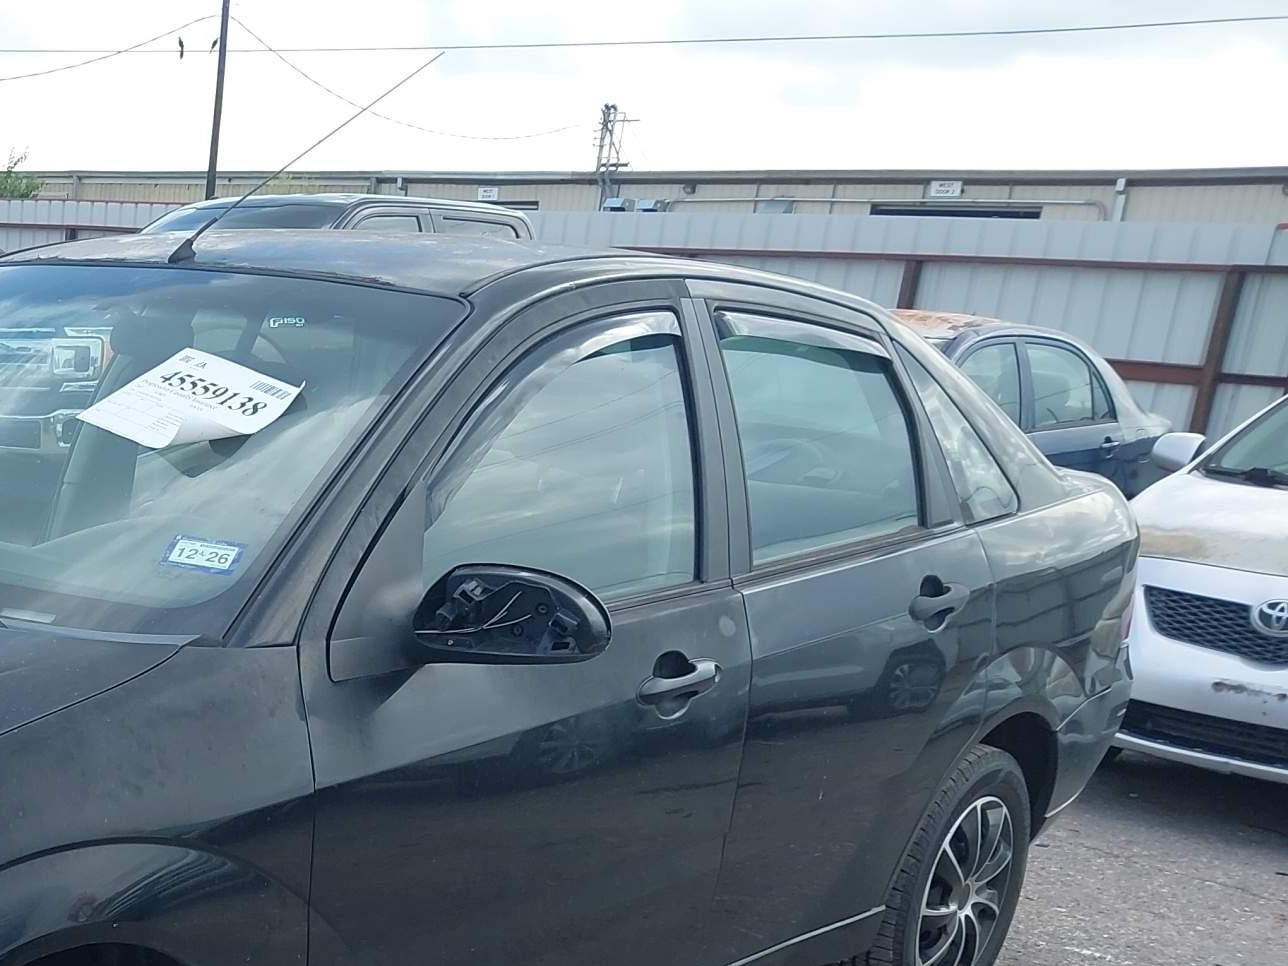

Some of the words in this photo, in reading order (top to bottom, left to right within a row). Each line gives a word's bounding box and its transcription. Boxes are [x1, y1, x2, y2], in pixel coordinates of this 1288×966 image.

[159, 370, 268, 417] 45559138
[177, 547, 199, 560] 12
[205, 551, 231, 565] 26
